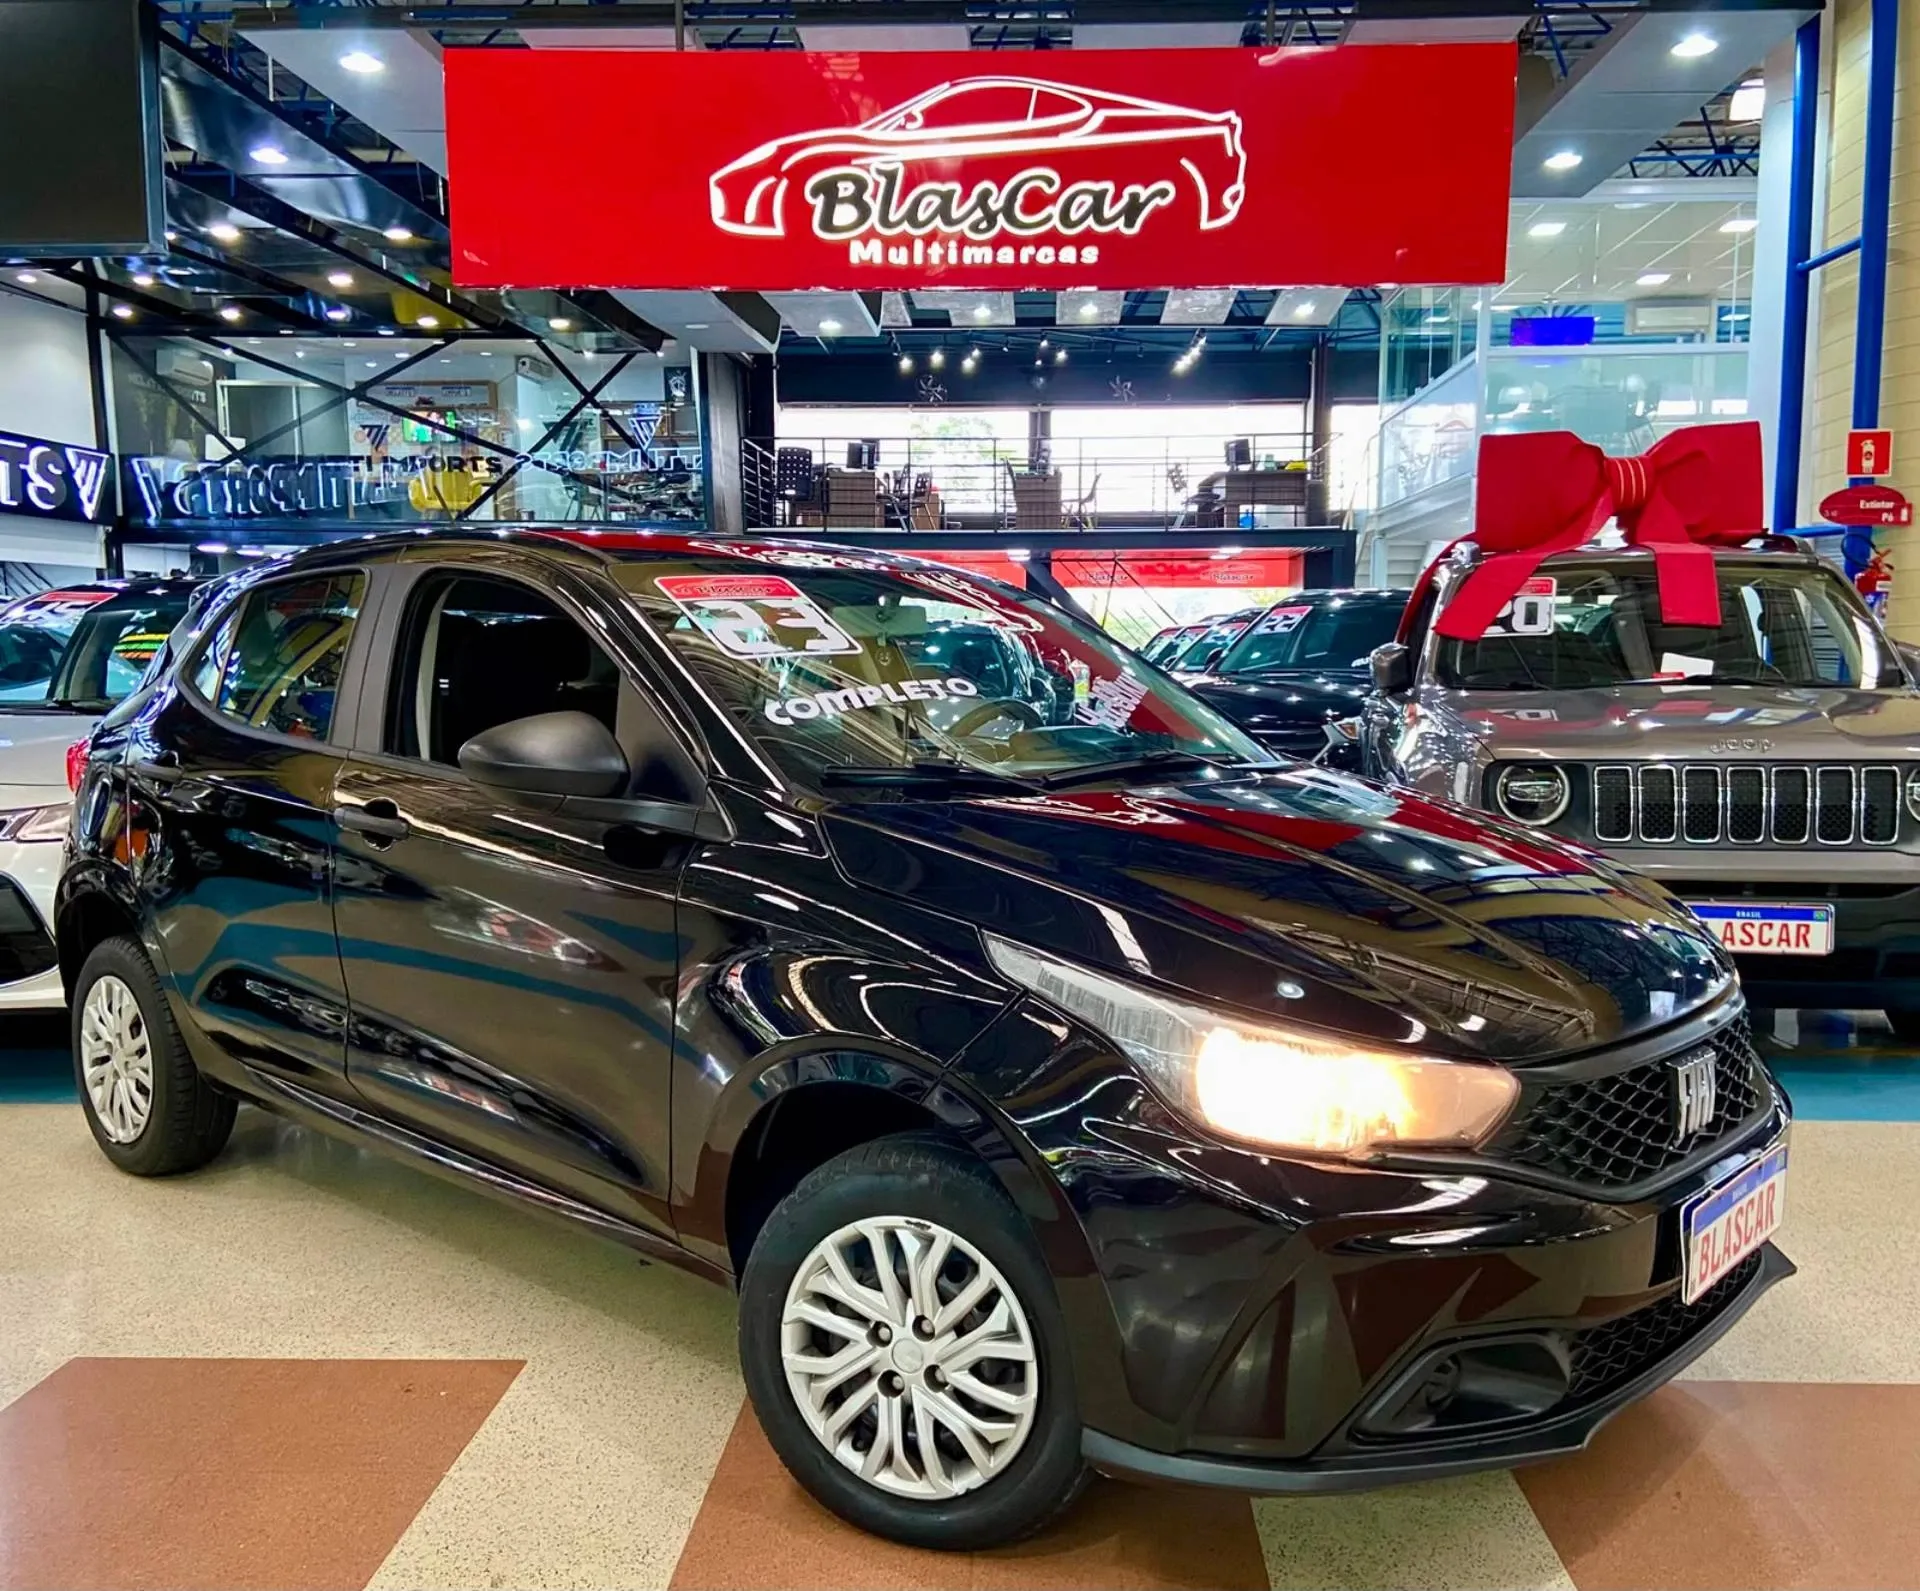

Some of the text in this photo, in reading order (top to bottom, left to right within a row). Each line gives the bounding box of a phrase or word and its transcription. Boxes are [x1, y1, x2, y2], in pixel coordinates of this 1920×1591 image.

[805, 161, 1175, 240] BlasCar
[849, 239, 1099, 266] Multimarcas
[694, 600, 850, 653] 23
[764, 677, 978, 725] COMPLETO
[1710, 738, 1775, 754] Jeep
[1721, 921, 1811, 949] ASCAR
[1736, 910, 1762, 919] BRASIL
[1675, 1052, 1717, 1147] FIAT
[1698, 1182, 1776, 1285] BLASCAR
